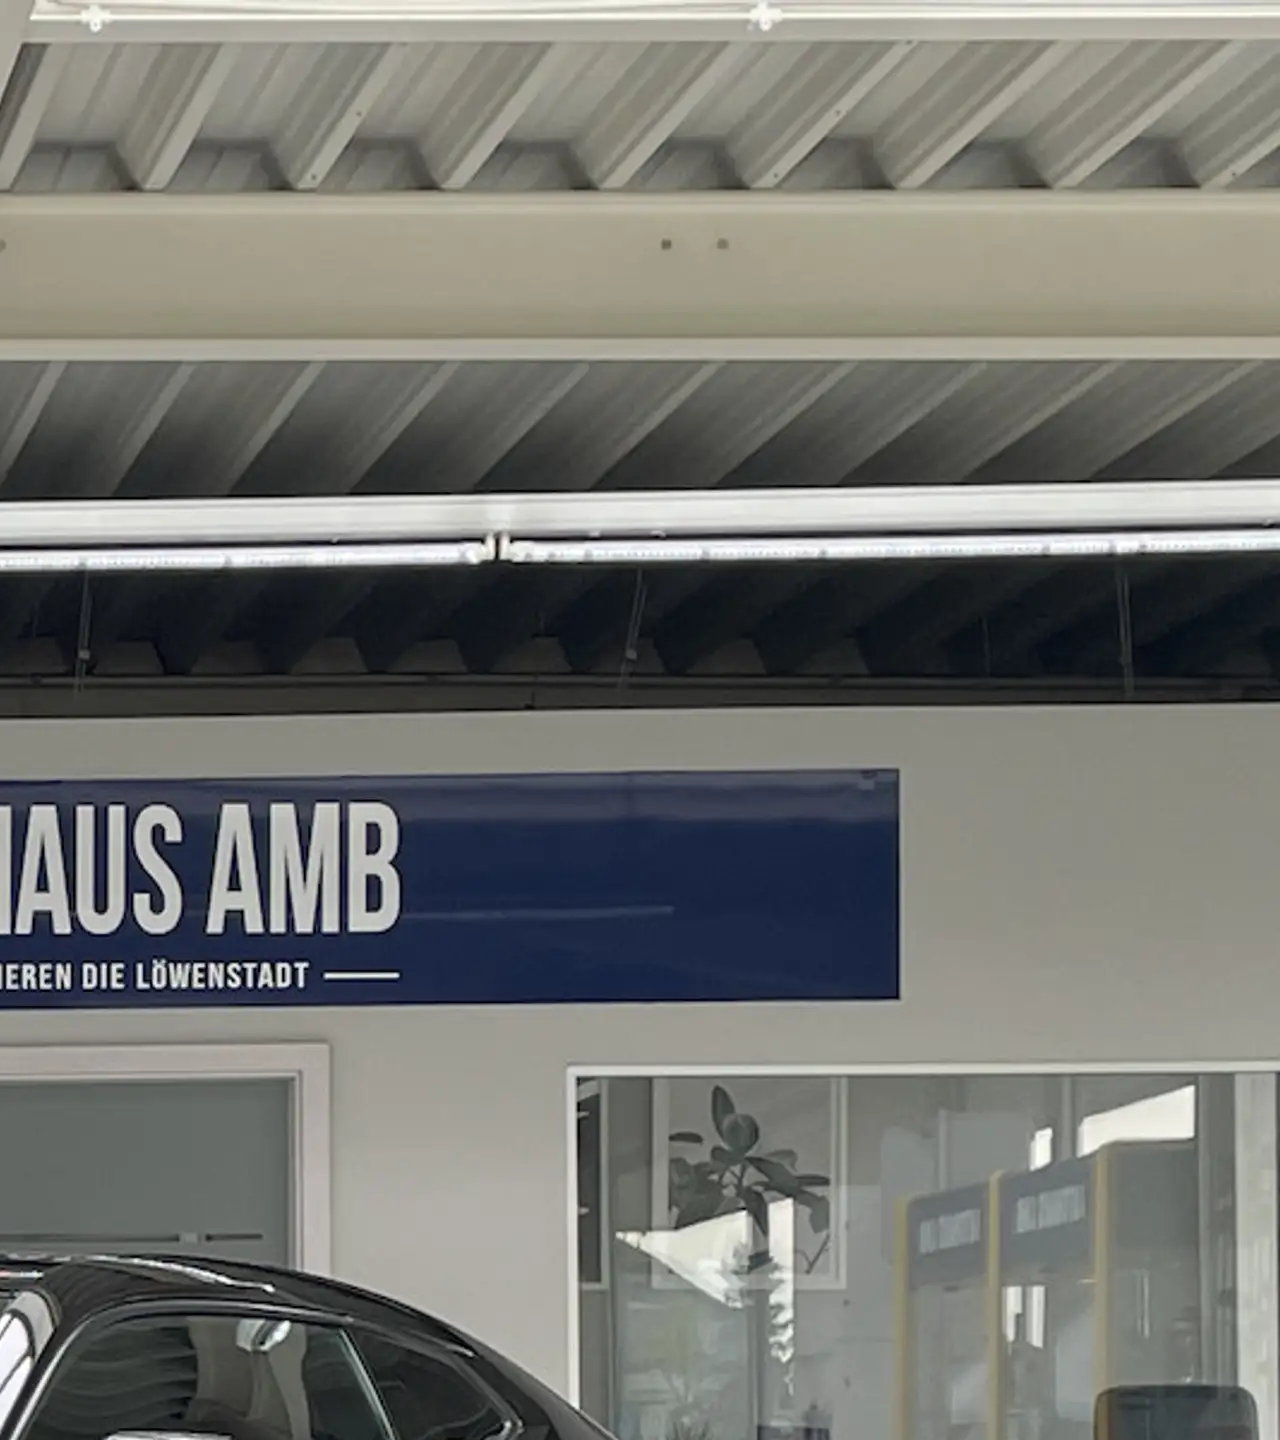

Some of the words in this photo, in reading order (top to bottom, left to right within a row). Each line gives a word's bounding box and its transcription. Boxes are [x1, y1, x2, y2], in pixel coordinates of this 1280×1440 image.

[205, 801, 401, 936] AMB
[81, 963, 126, 990] DIE
[136, 960, 309, 990] LÖWENSTADT
